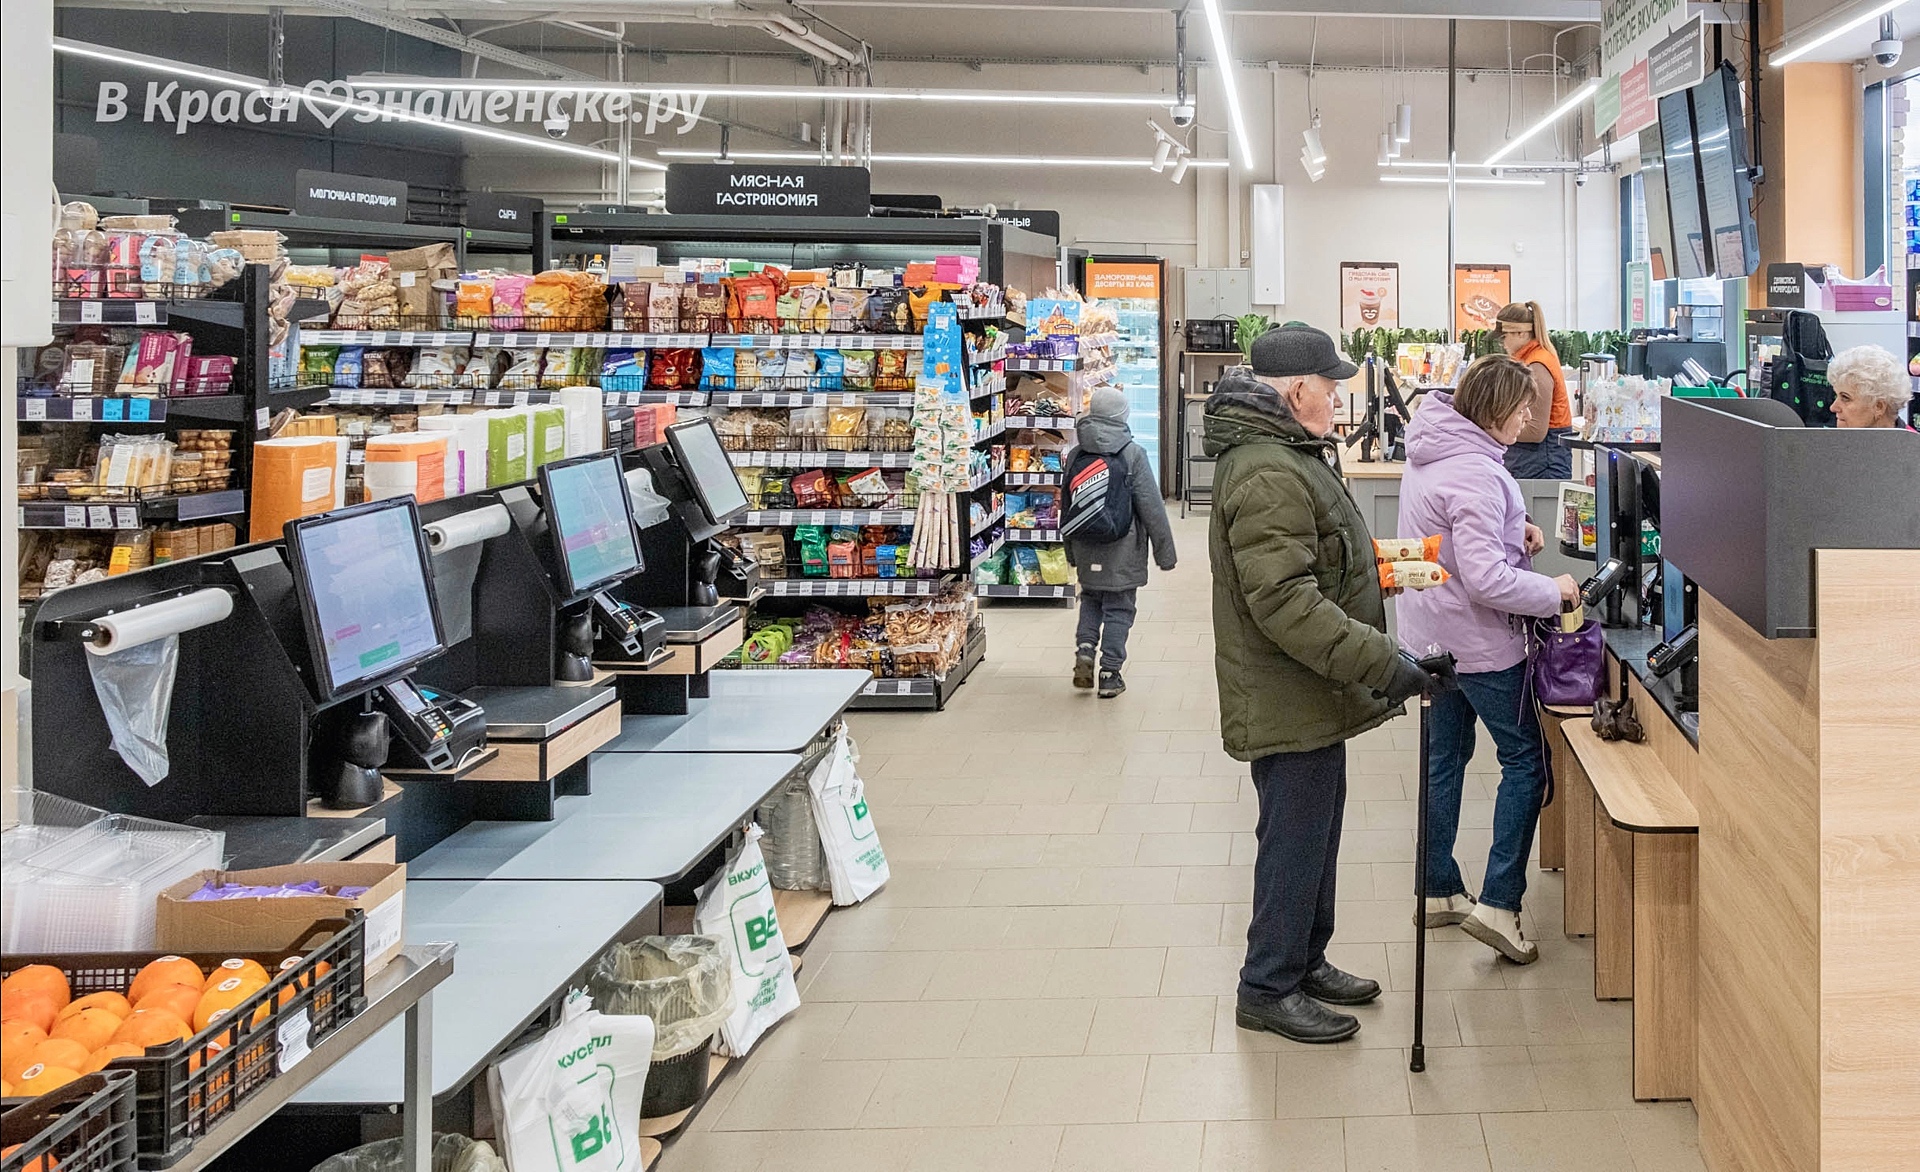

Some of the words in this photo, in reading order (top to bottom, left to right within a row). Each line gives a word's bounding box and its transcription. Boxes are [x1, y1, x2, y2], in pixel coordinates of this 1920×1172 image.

[730, 174, 804, 188] МЯСНАЯ
[310, 187, 356, 202] МОЛОЧНАЯ
[356, 193, 397, 207] ПРОДУКЦИЯ
[716, 192, 818, 207] ГАСТРОНОМИЯ
[498, 208, 517, 219] СЫРЫ
